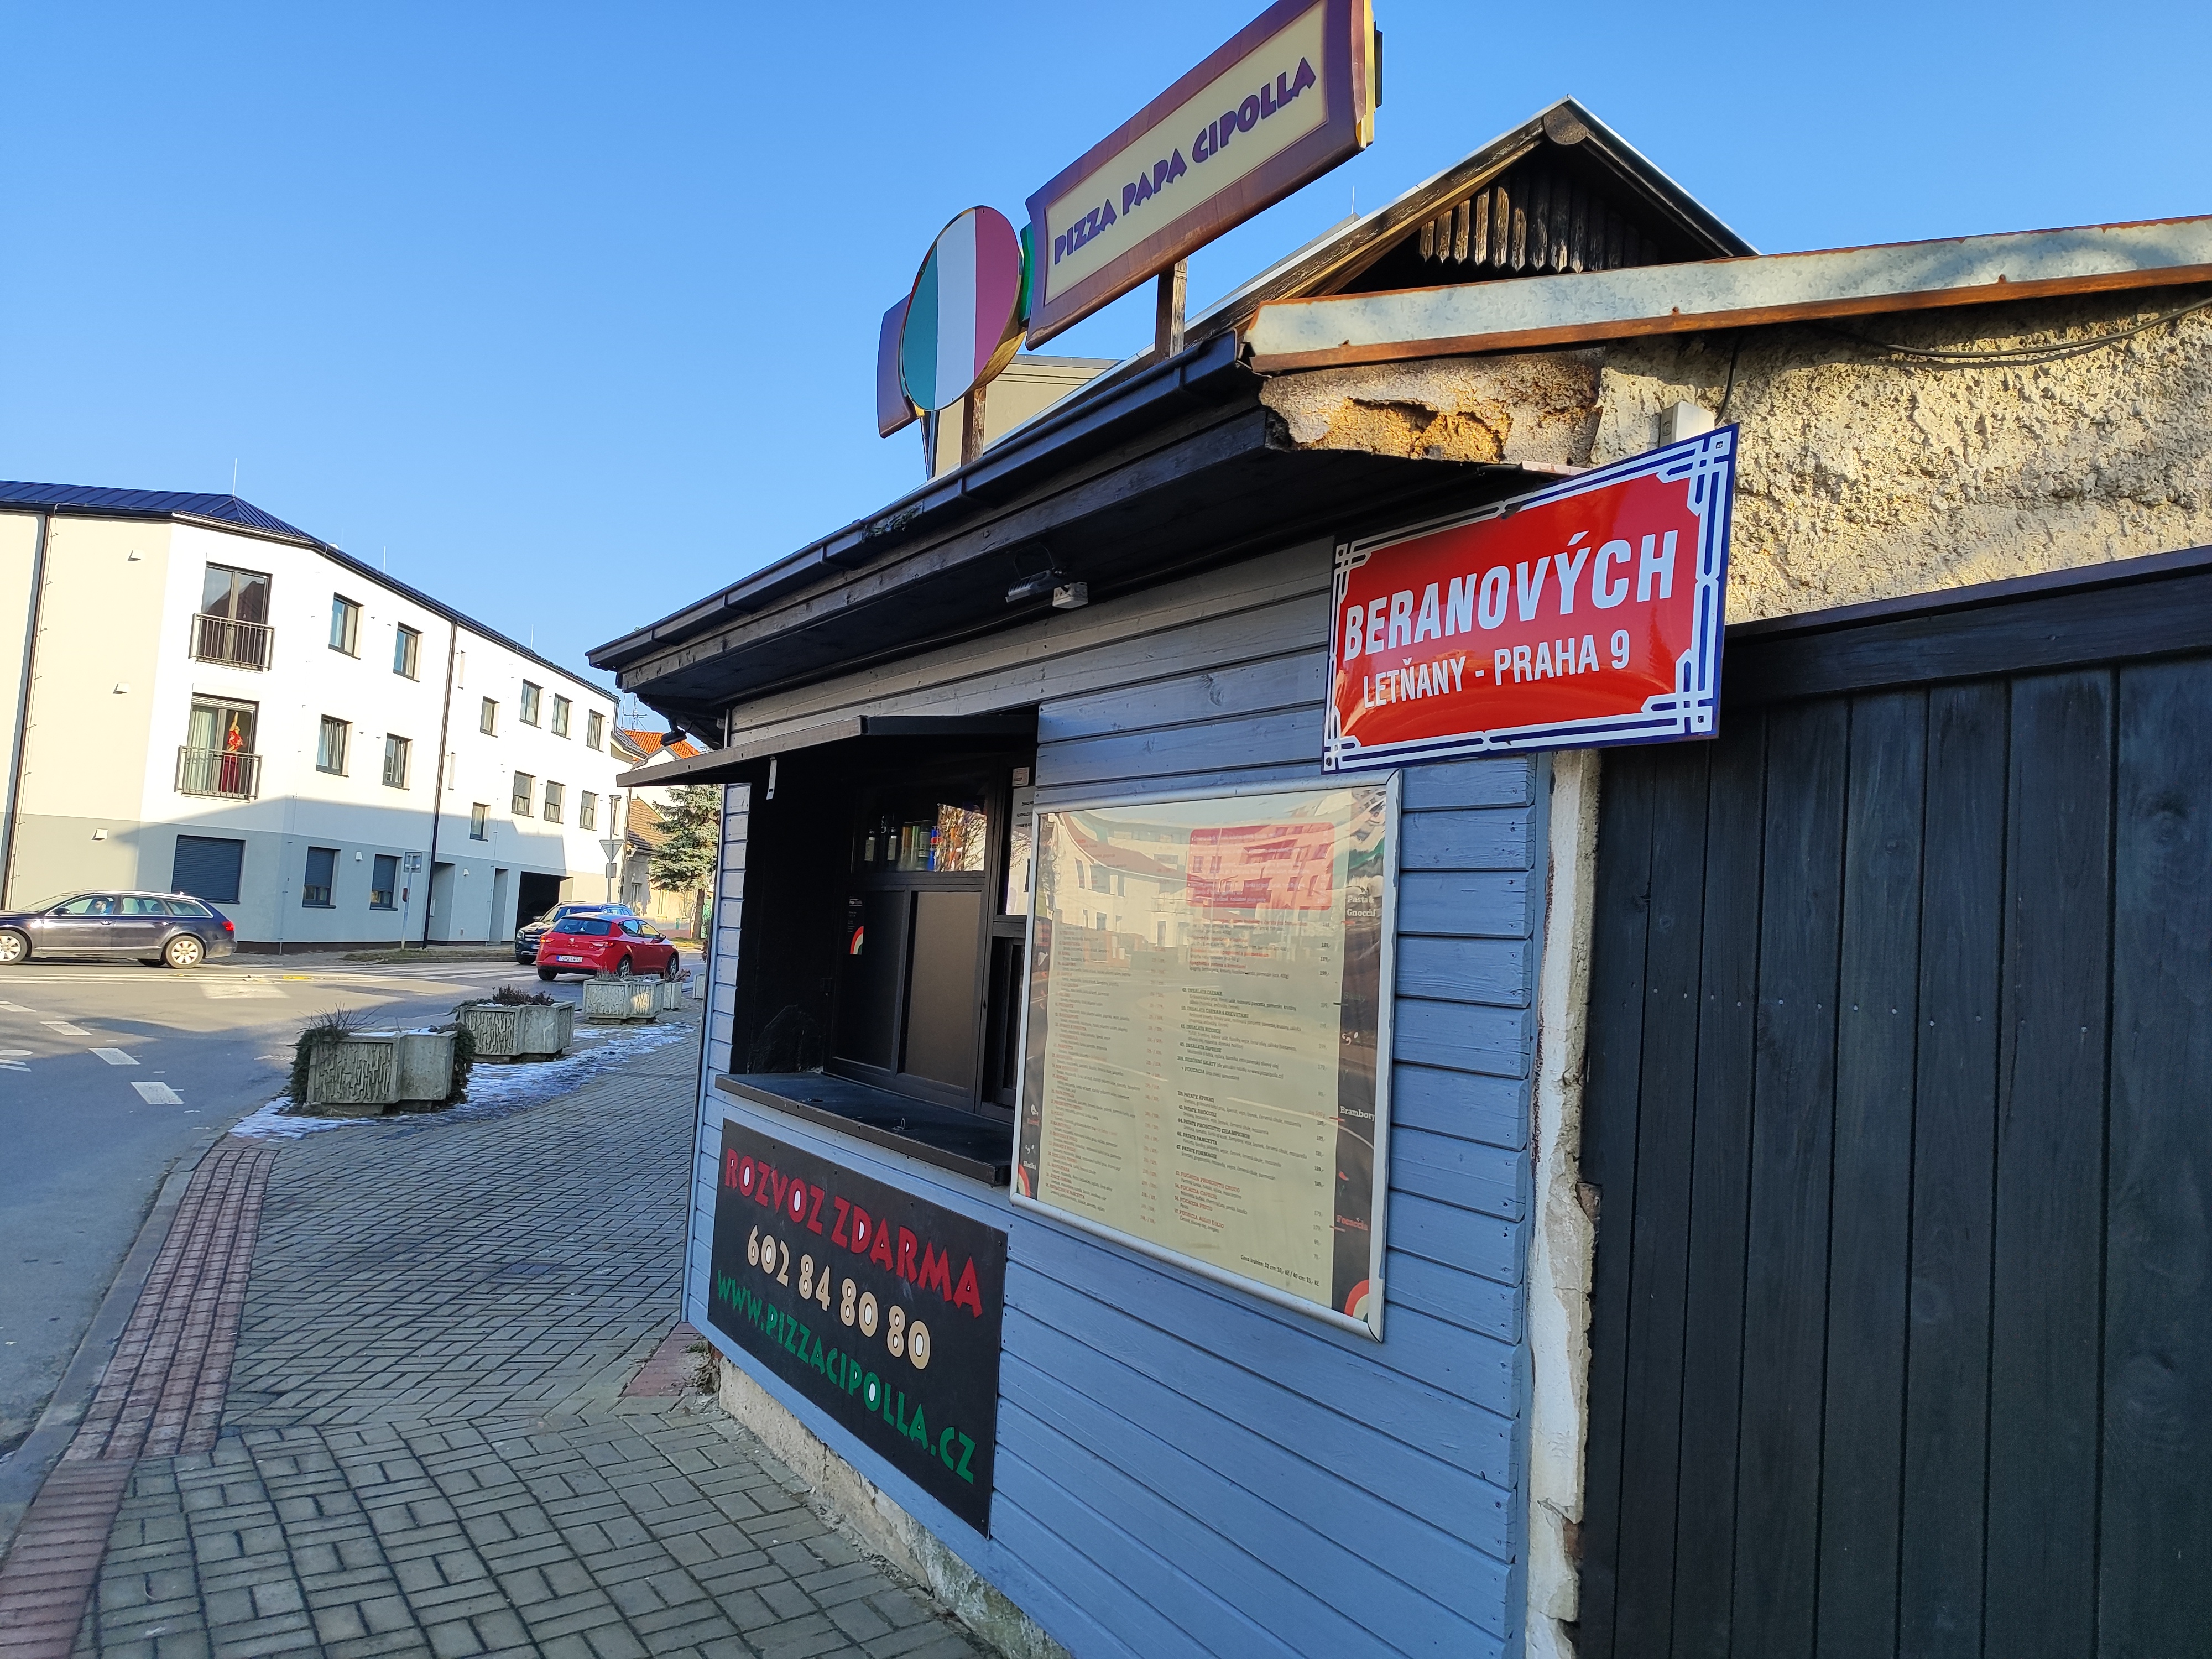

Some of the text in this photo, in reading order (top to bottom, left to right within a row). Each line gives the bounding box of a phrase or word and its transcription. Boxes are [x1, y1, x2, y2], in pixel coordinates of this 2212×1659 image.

[1054, 56, 1316, 264] PIZZA PAPA CIPOLLA
[1344, 531, 1678, 661] BERANOVÝCH
[1363, 629, 1630, 708] LETŇANY - PRAHA 9
[1347, 909, 1375, 917] Gnocchi
[1348, 895, 1368, 904] Pasta
[1340, 1105, 1375, 1121] Brambory
[725, 1148, 983, 1318] ROZVOZ ZDARMA
[1240, 1254, 1249, 1262] Cena
[747, 1224, 931, 1369] 602 84 80 80
[718, 1270, 978, 1484] WWW.PIZZACIPOLLA.CZ
